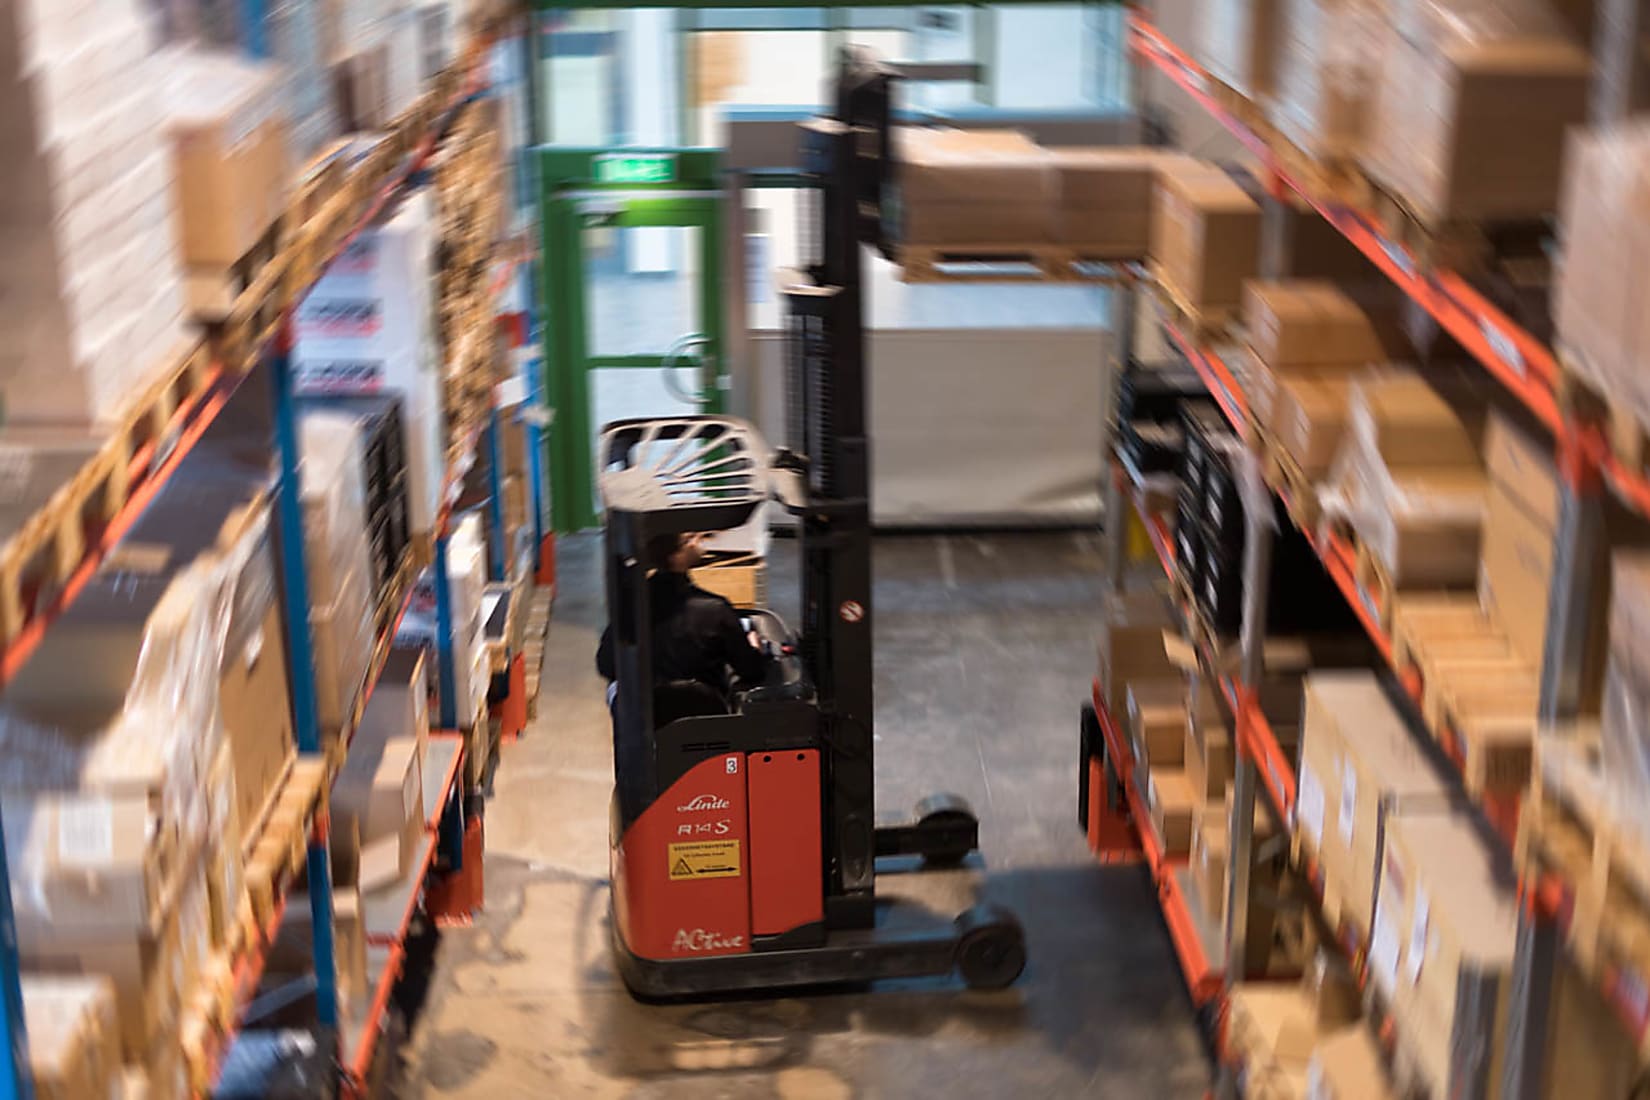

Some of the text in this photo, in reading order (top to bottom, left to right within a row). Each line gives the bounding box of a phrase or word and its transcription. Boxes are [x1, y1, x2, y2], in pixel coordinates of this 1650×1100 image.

[728, 760, 736, 772] 3
[677, 794, 730, 812] Linde
[678, 824, 692, 837] R
[714, 818, 732, 835] S
